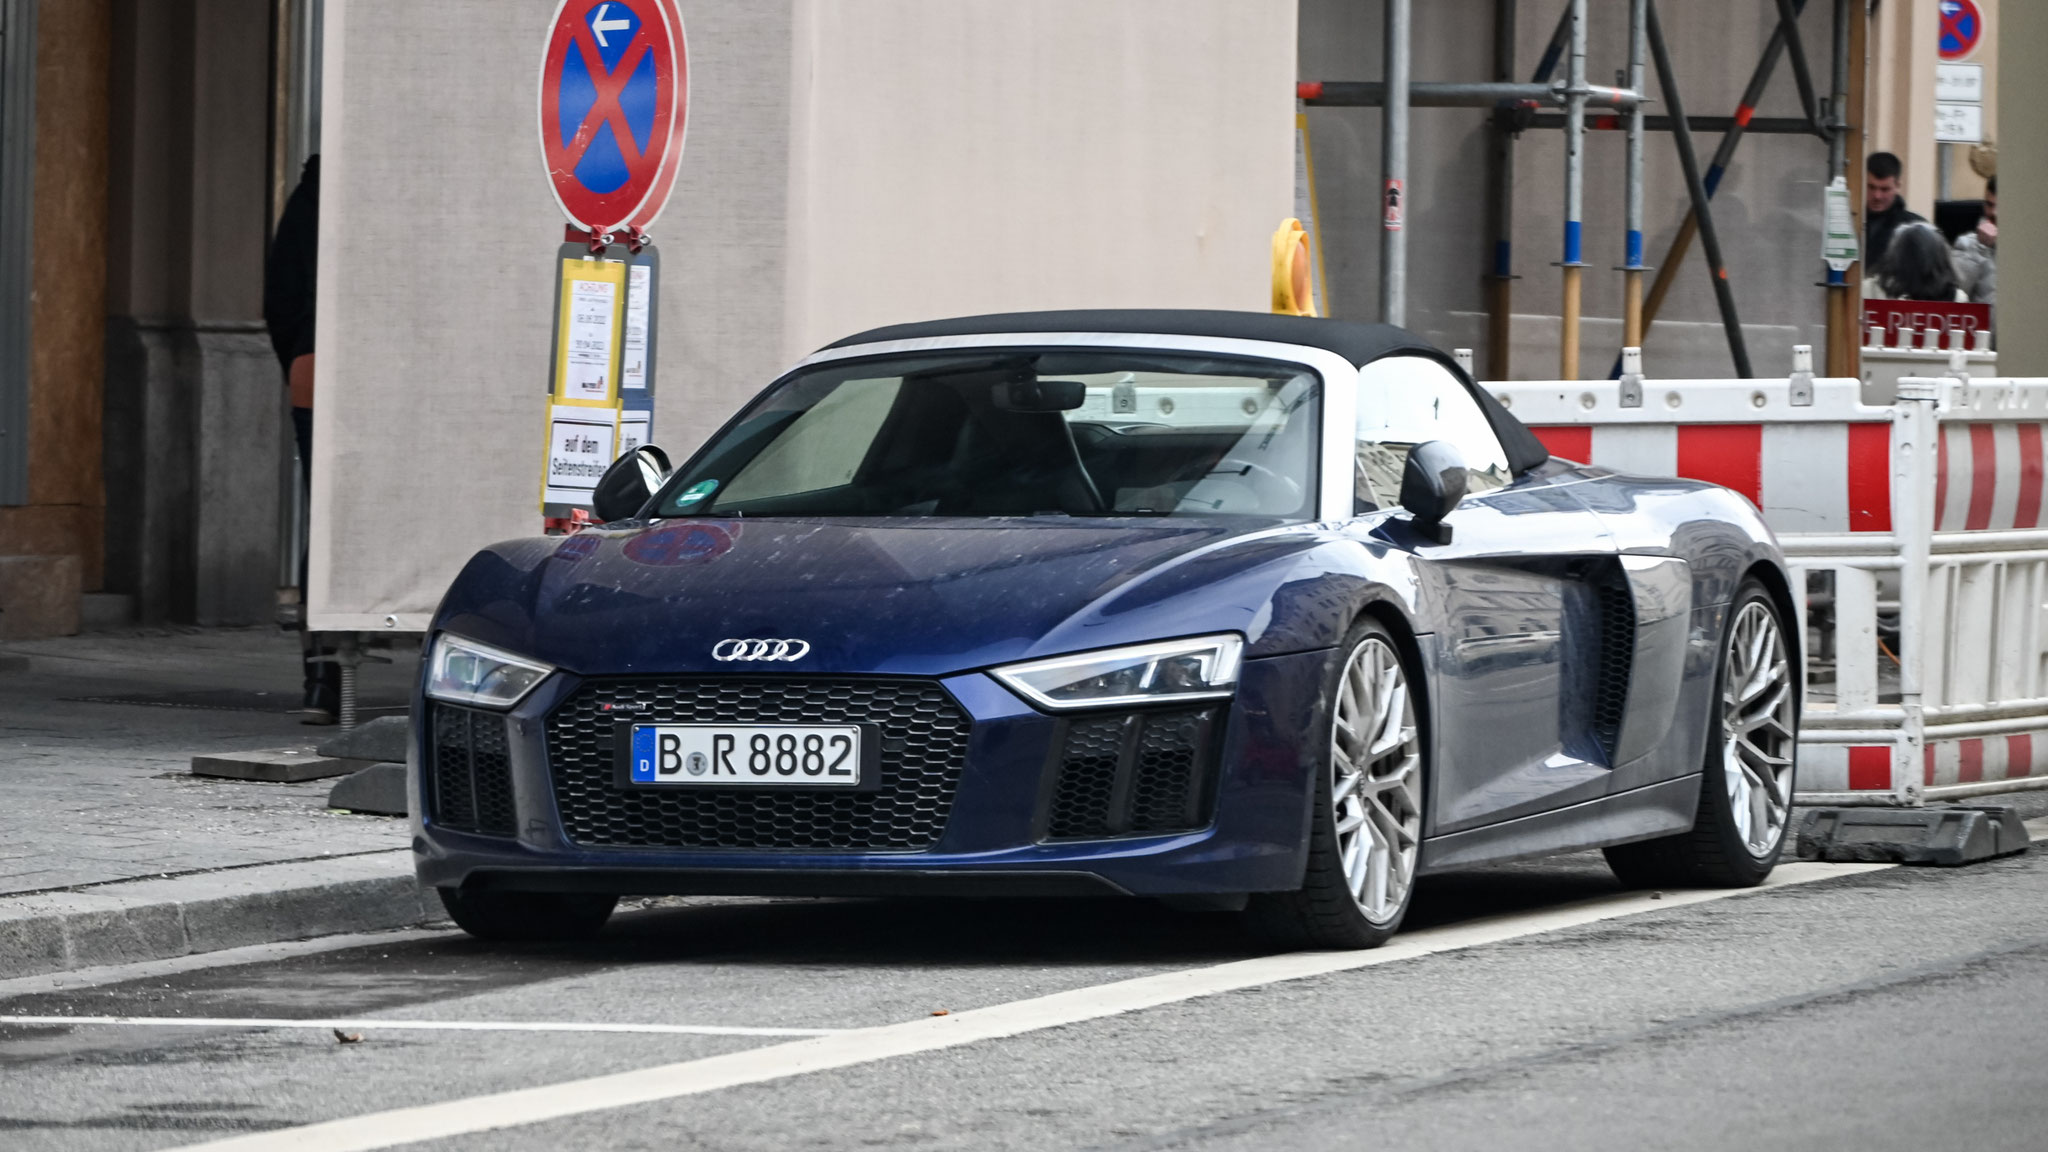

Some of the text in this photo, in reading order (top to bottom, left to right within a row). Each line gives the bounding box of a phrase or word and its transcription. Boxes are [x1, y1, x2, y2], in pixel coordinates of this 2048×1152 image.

[1887, 310, 1979, 337] RIEDER
[564, 434, 579, 453] auf
[581, 435, 599, 454] dem
[639, 759, 649, 772] D
[658, 733, 852, 776] B R 8882
